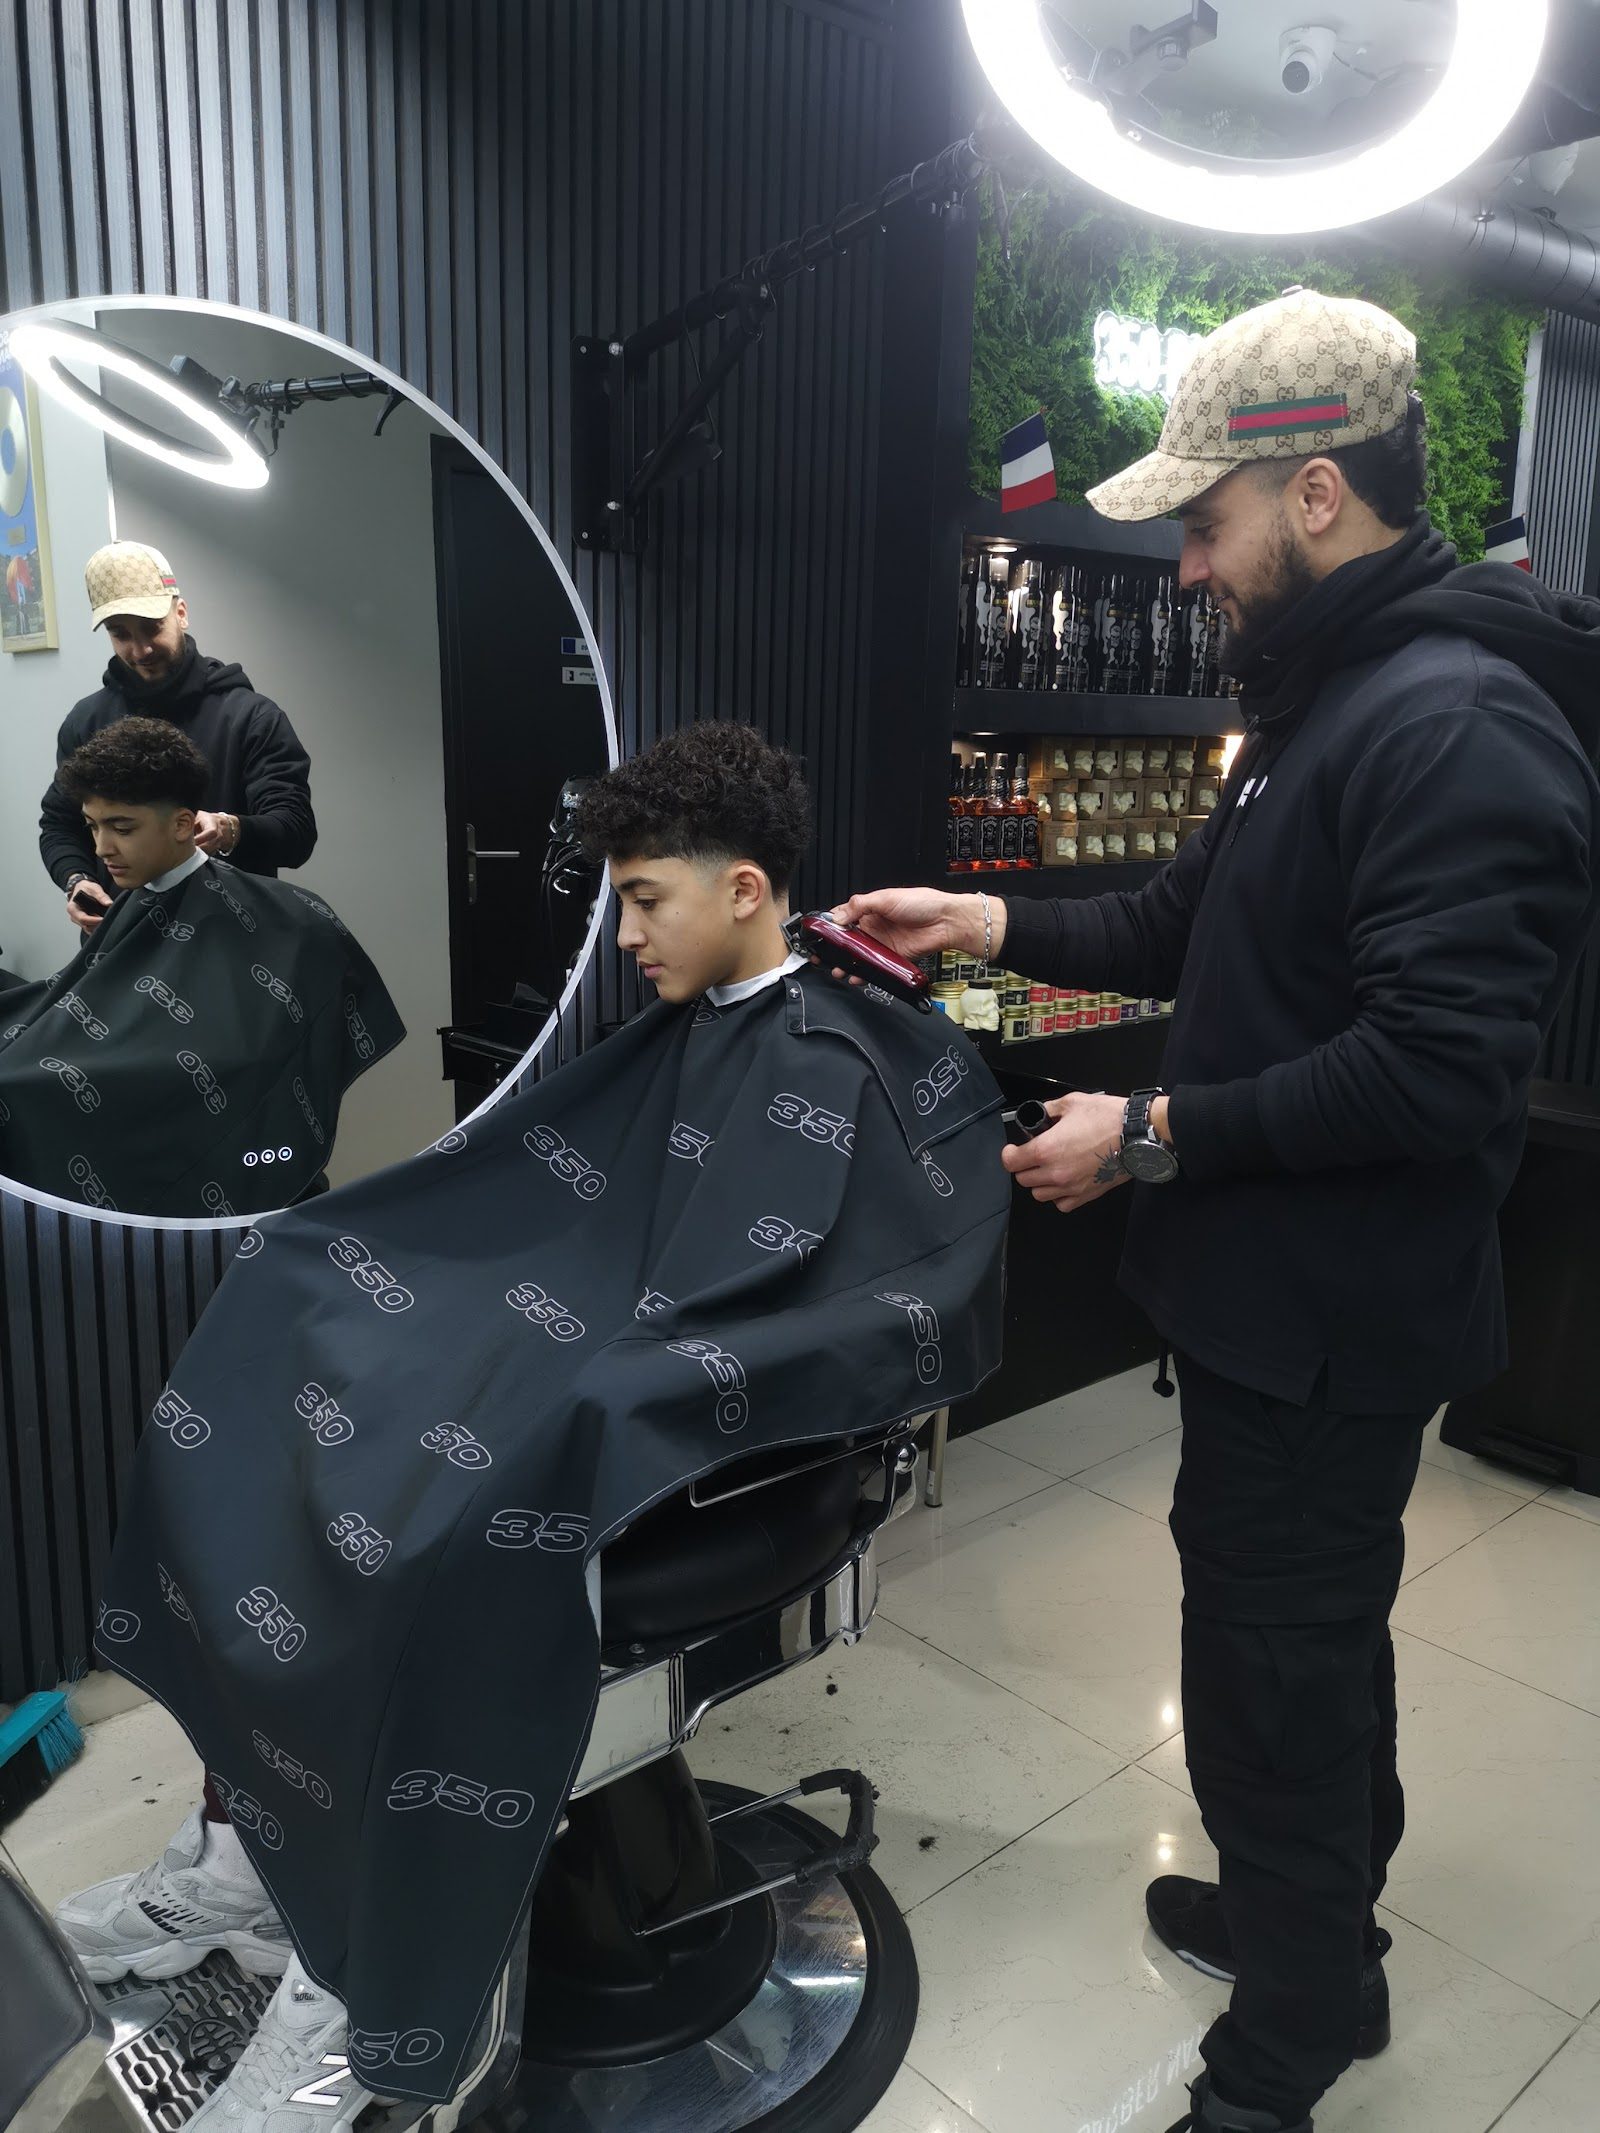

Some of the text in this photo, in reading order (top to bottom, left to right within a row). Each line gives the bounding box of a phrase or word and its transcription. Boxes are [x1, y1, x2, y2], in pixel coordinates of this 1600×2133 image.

[912, 1044, 970, 1116] 350
[523, 1124, 607, 1201] 350
[327, 1236, 415, 1314] 350
[505, 1282, 586, 1343] 350
[873, 1291, 943, 1385] 350
[152, 1382, 212, 1450] 50
[294, 1382, 355, 1447] 350
[666, 1339, 749, 1434] 350
[420, 1421, 493, 1471] 350
[326, 1511, 393, 1576] 350
[236, 1586, 308, 1662] 350
[252, 1729, 333, 1809] 350
[386, 1769, 536, 1829] 350
[348, 2022, 445, 2070] 50
